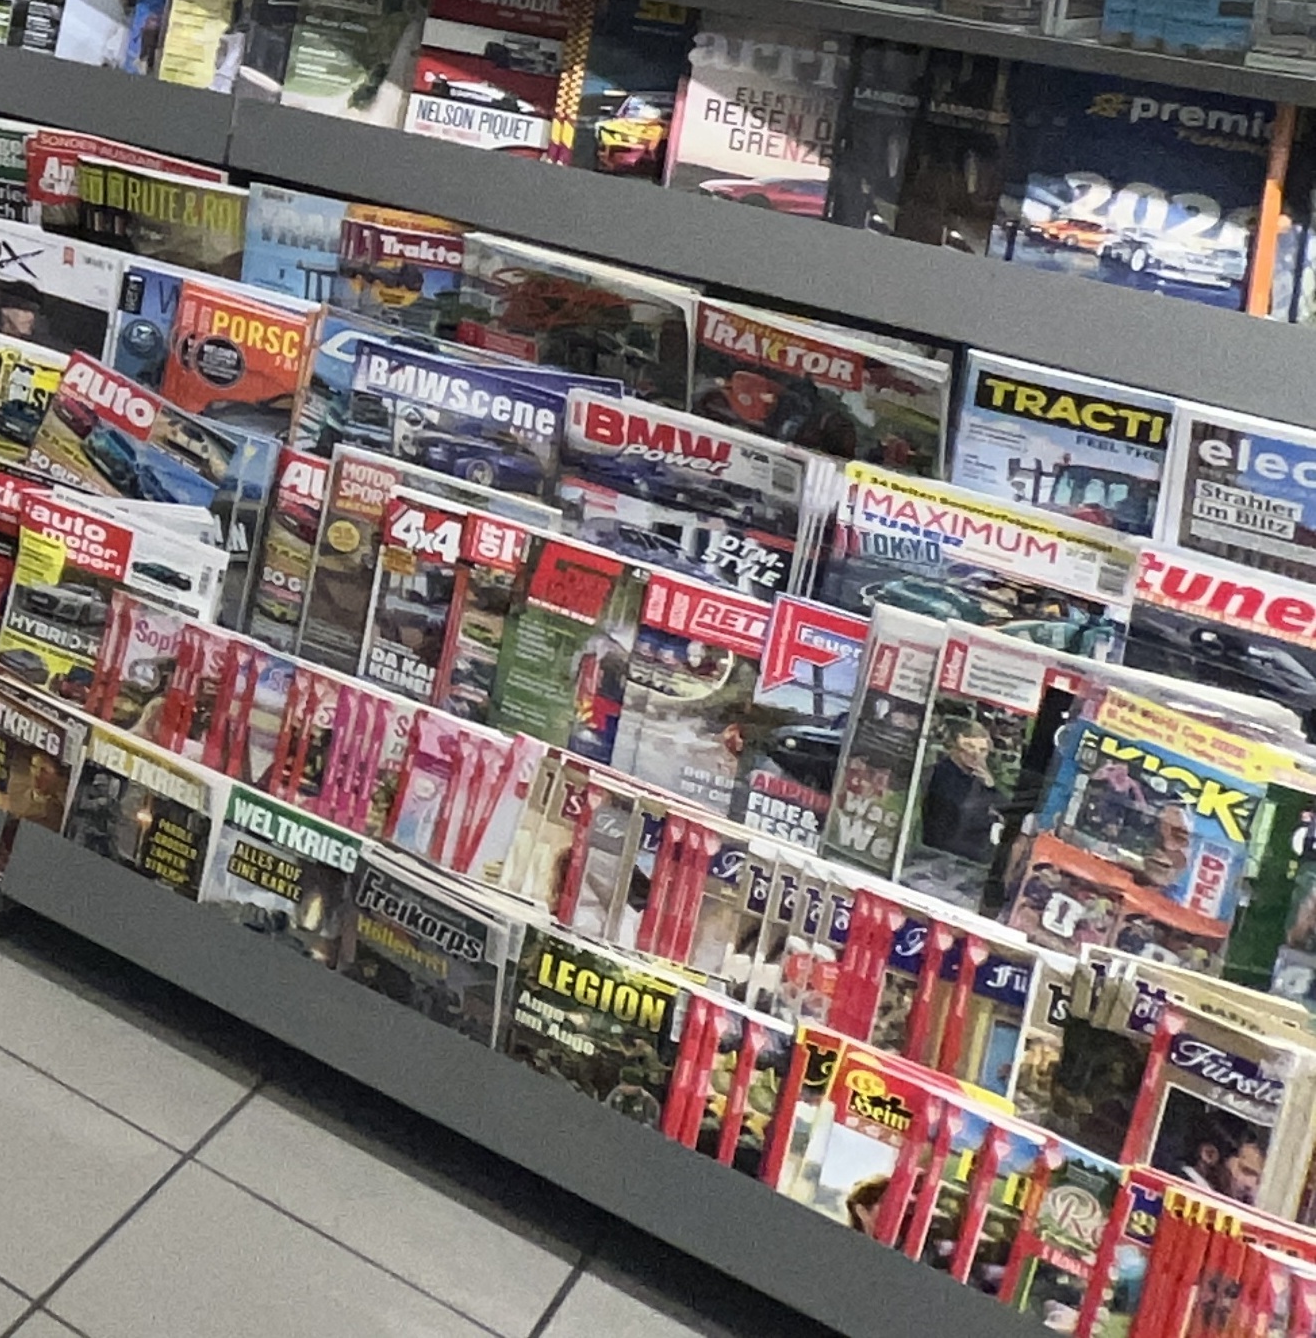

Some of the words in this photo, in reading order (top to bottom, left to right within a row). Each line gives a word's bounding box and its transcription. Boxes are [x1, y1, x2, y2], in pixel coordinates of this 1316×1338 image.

[415, 98, 475, 130] NELSON
[478, 111, 534, 143] PIQUET
[705, 98, 804, 137] REISEN
[126, 176, 182, 220] RUTE
[379, 231, 463, 264] Trakto
[209, 308, 301, 360] PORSC
[702, 307, 857, 383] TRAKTOR
[984, 378, 1165, 443] TRACTI
[583, 402, 732, 471] BMW
[620, 441, 731, 477] power
[1197, 500, 1231, 520] im
[1236, 509, 1290, 535] Blitz
[1198, 481, 1298, 519] Strahler
[30, 507, 108, 544] auto
[41, 526, 121, 560] motor
[391, 509, 466, 563] 4x4
[858, 528, 943, 566] TOKYO
[860, 485, 1060, 566] MAXIMUM
[861, 509, 966, 549] TUNER
[700, 547, 782, 589] STYLE
[233, 797, 359, 874] WELTKRIEG
[227, 856, 261, 881] EINE
[261, 874, 303, 903] KARTE
[235, 841, 274, 866] ALLES
[273, 861, 303, 883] AUF
[357, 868, 483, 962] Freikorps
[538, 952, 666, 1032] LEGION
